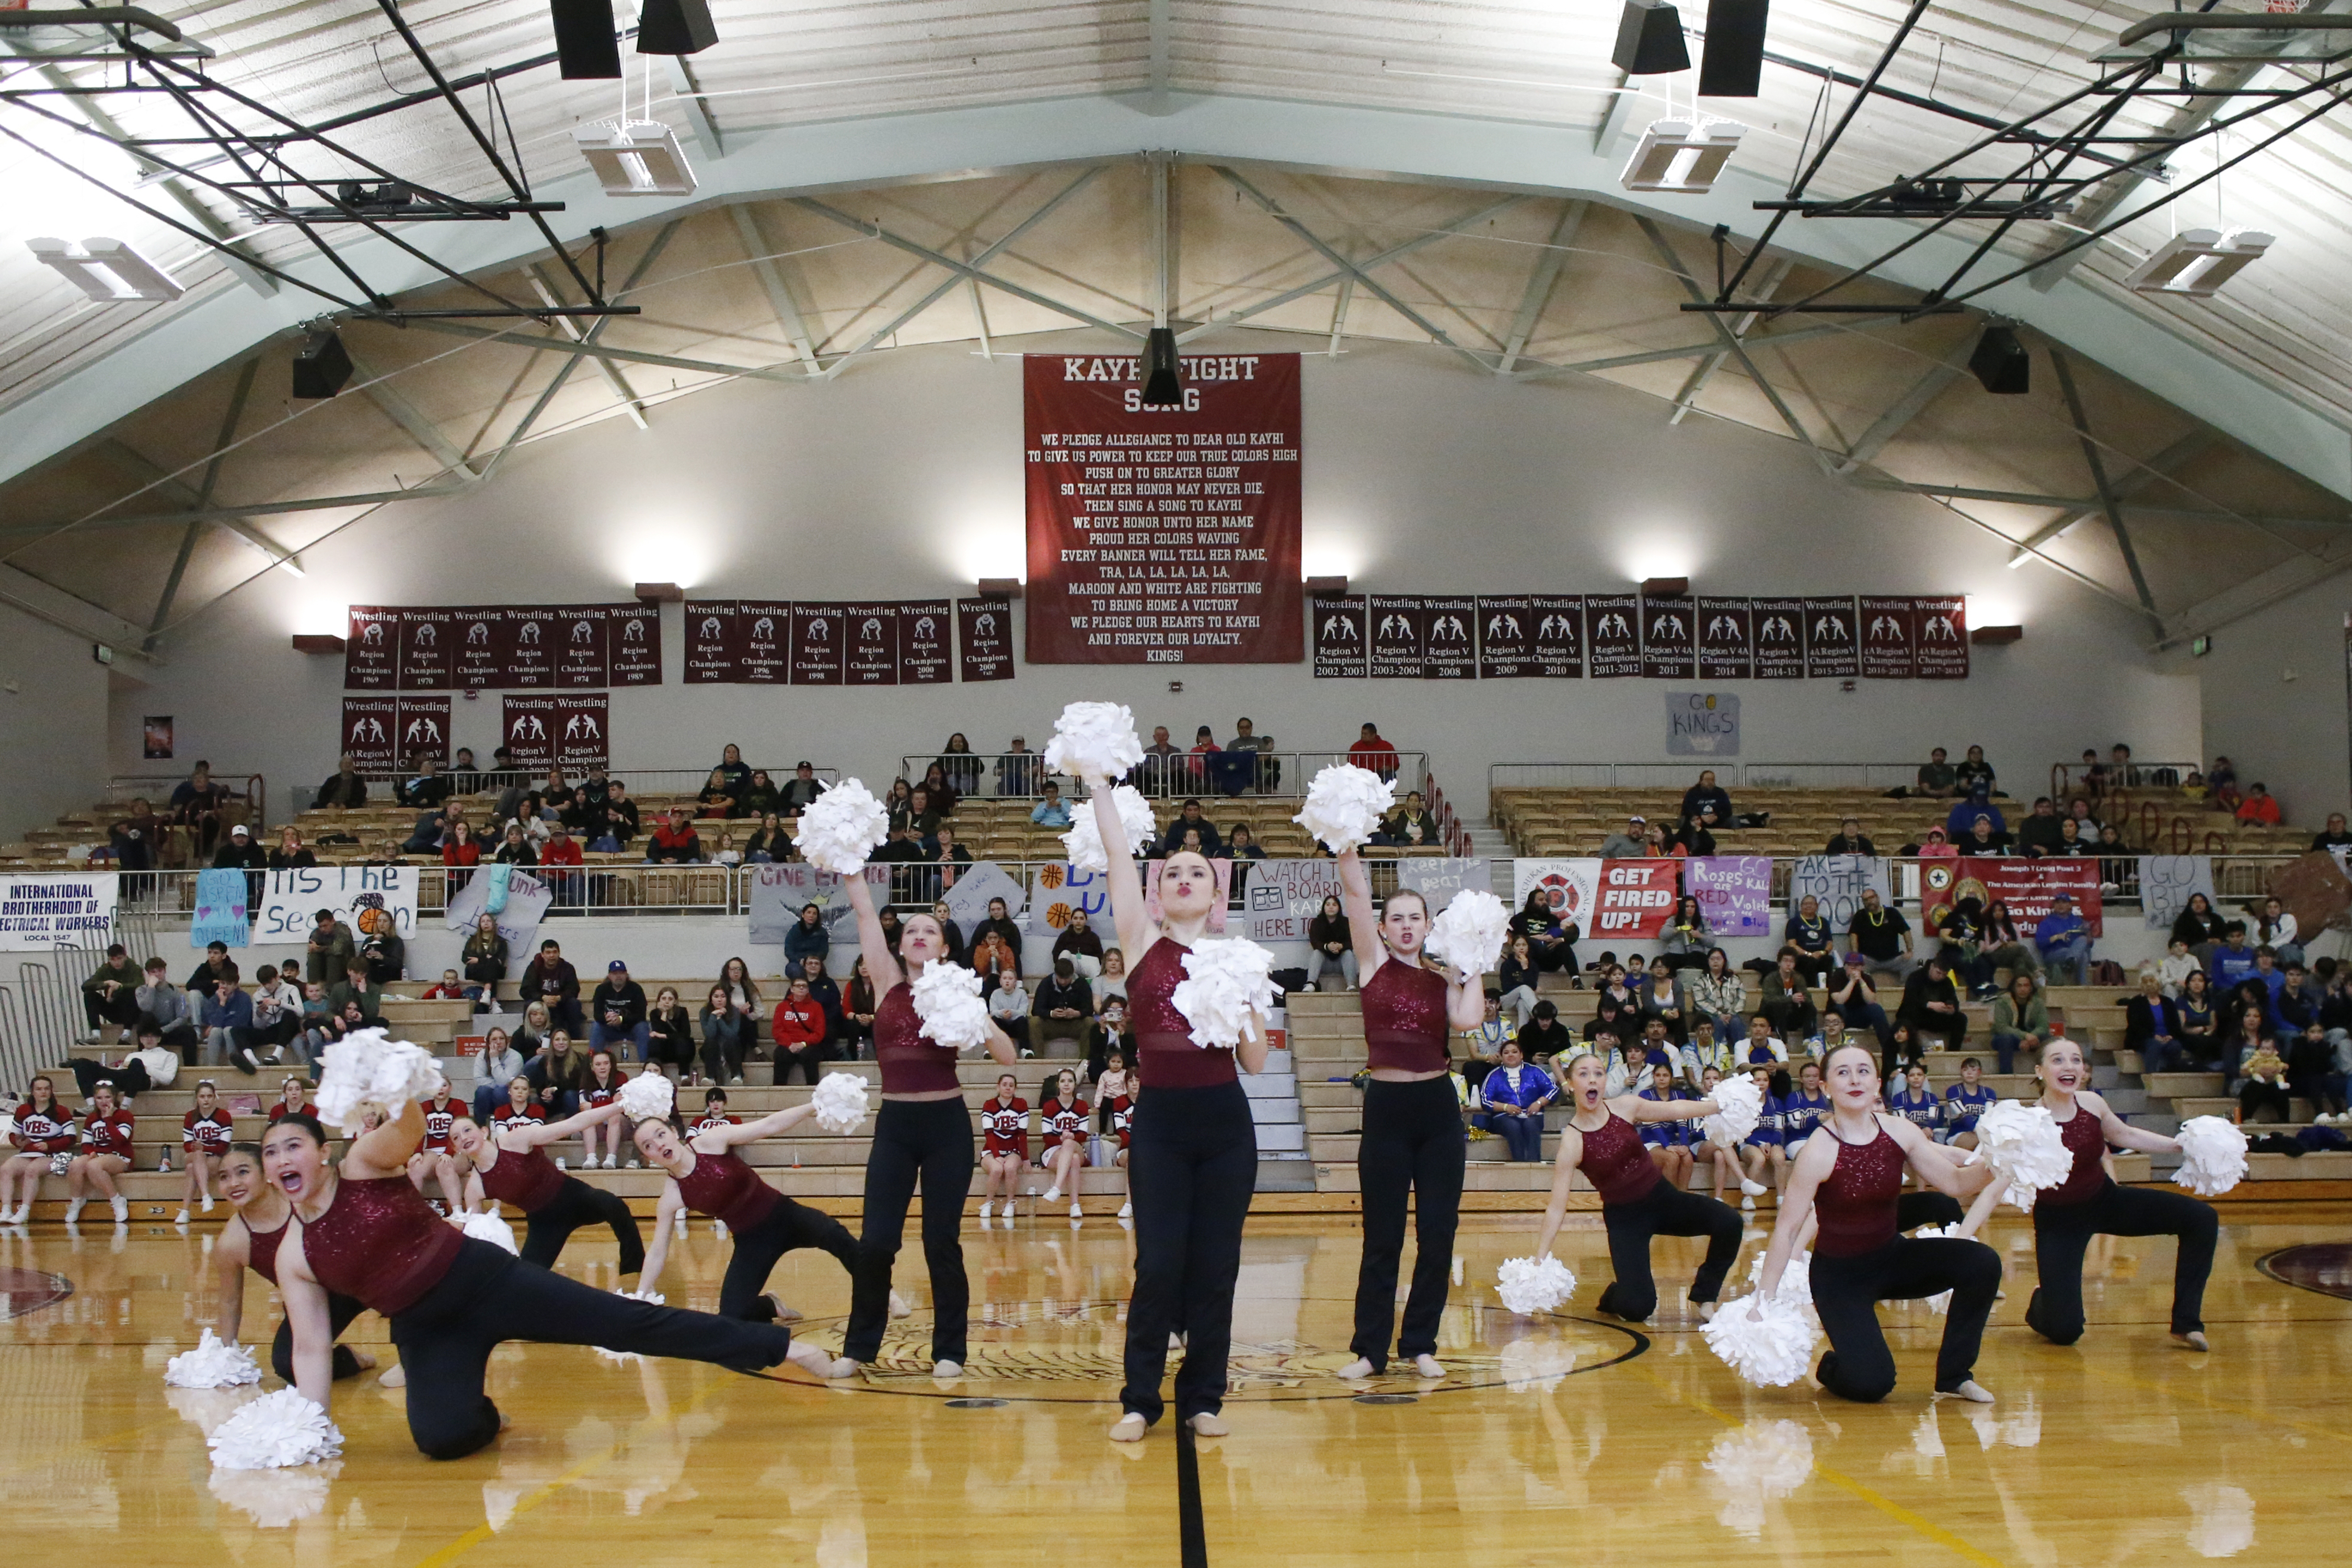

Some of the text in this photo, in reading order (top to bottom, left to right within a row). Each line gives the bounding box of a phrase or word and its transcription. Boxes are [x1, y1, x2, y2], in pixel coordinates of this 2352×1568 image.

[1064, 358, 1140, 381] KAYH
[1124, 388, 1200, 412] SG
[1042, 433, 1283, 445] WE PLEDGE ALLEGIANCE TO DEAR OLD KAYHI
[1028, 449, 1297, 462] TO GIVE US POWER TO KEEP OUR TRUE COLORS HIGH
[1086, 467, 1240, 478] PUSH ON TO GREATER GLORY
[1085, 500, 1241, 511] THEN SING A SONG TO KAYHI
[1062, 549, 1267, 561] EVERY BANNER WILL TELL HER FAME,
[1069, 583, 1261, 594] MAROON AND WHITE ARE FIGHTING
[1092, 599, 1238, 610] TO BRING HOME A VICTORY
[1315, 599, 1364, 610] Wrestling
[1478, 599, 1528, 608] Wrestling
[1700, 599, 1749, 611] Wrestling
[611, 608, 657, 616] Wrestling
[688, 605, 734, 615] Wrestling
[403, 613, 449, 621] Wrestling
[1088, 633, 1241, 644] AND FOREVER OUR LOYALTY.
[1147, 650, 1182, 661] KINGS!
[1319, 647, 1350, 657] Region
[1314, 654, 1366, 665] Champions
[754, 667, 769, 676] 1996
[979, 661, 996, 671] 2000
[1317, 667, 1364, 675] 2002 2003
[1370, 666, 1421, 675] 2003-2004
[1439, 667, 1461, 676] 2008
[1495, 665, 1518, 674] 2009
[1545, 666, 1566, 674] 2010
[1594, 664, 1639, 675] 2011-2012
[1658, 665, 1679, 675] 2013
[1715, 666, 1735, 676] 2014
[1762, 667, 1796, 676] 2014-15
[558, 698, 606, 708] Wrestling
[1690, 694, 1716, 710] GO
[1674, 712, 1733, 736] KINGS
[1258, 862, 1321, 882] WATCH
[2000, 865, 2030, 873] Joseph
[2150, 855, 2196, 885] GO
[205, 871, 230, 885] GO
[1609, 868, 1654, 885] GET
[1520, 864, 1590, 907] KETCHIKAN PROFESSIONAL
[1714, 882, 1731, 891] are
[1798, 874, 1873, 895] TO THE
[10, 884, 93, 898] INTERNATIONAL
[201, 885, 244, 903] ASPEN
[1287, 882, 1342, 900] BOARD
[1604, 890, 1671, 907] FIRED
[1694, 889, 1728, 905] RED
[2, 900, 99, 915] BROTHERHOOD OF
[55, 916, 109, 930] WORKERS
[1600, 912, 1642, 929] UP!
[1255, 918, 1295, 937] HERE
